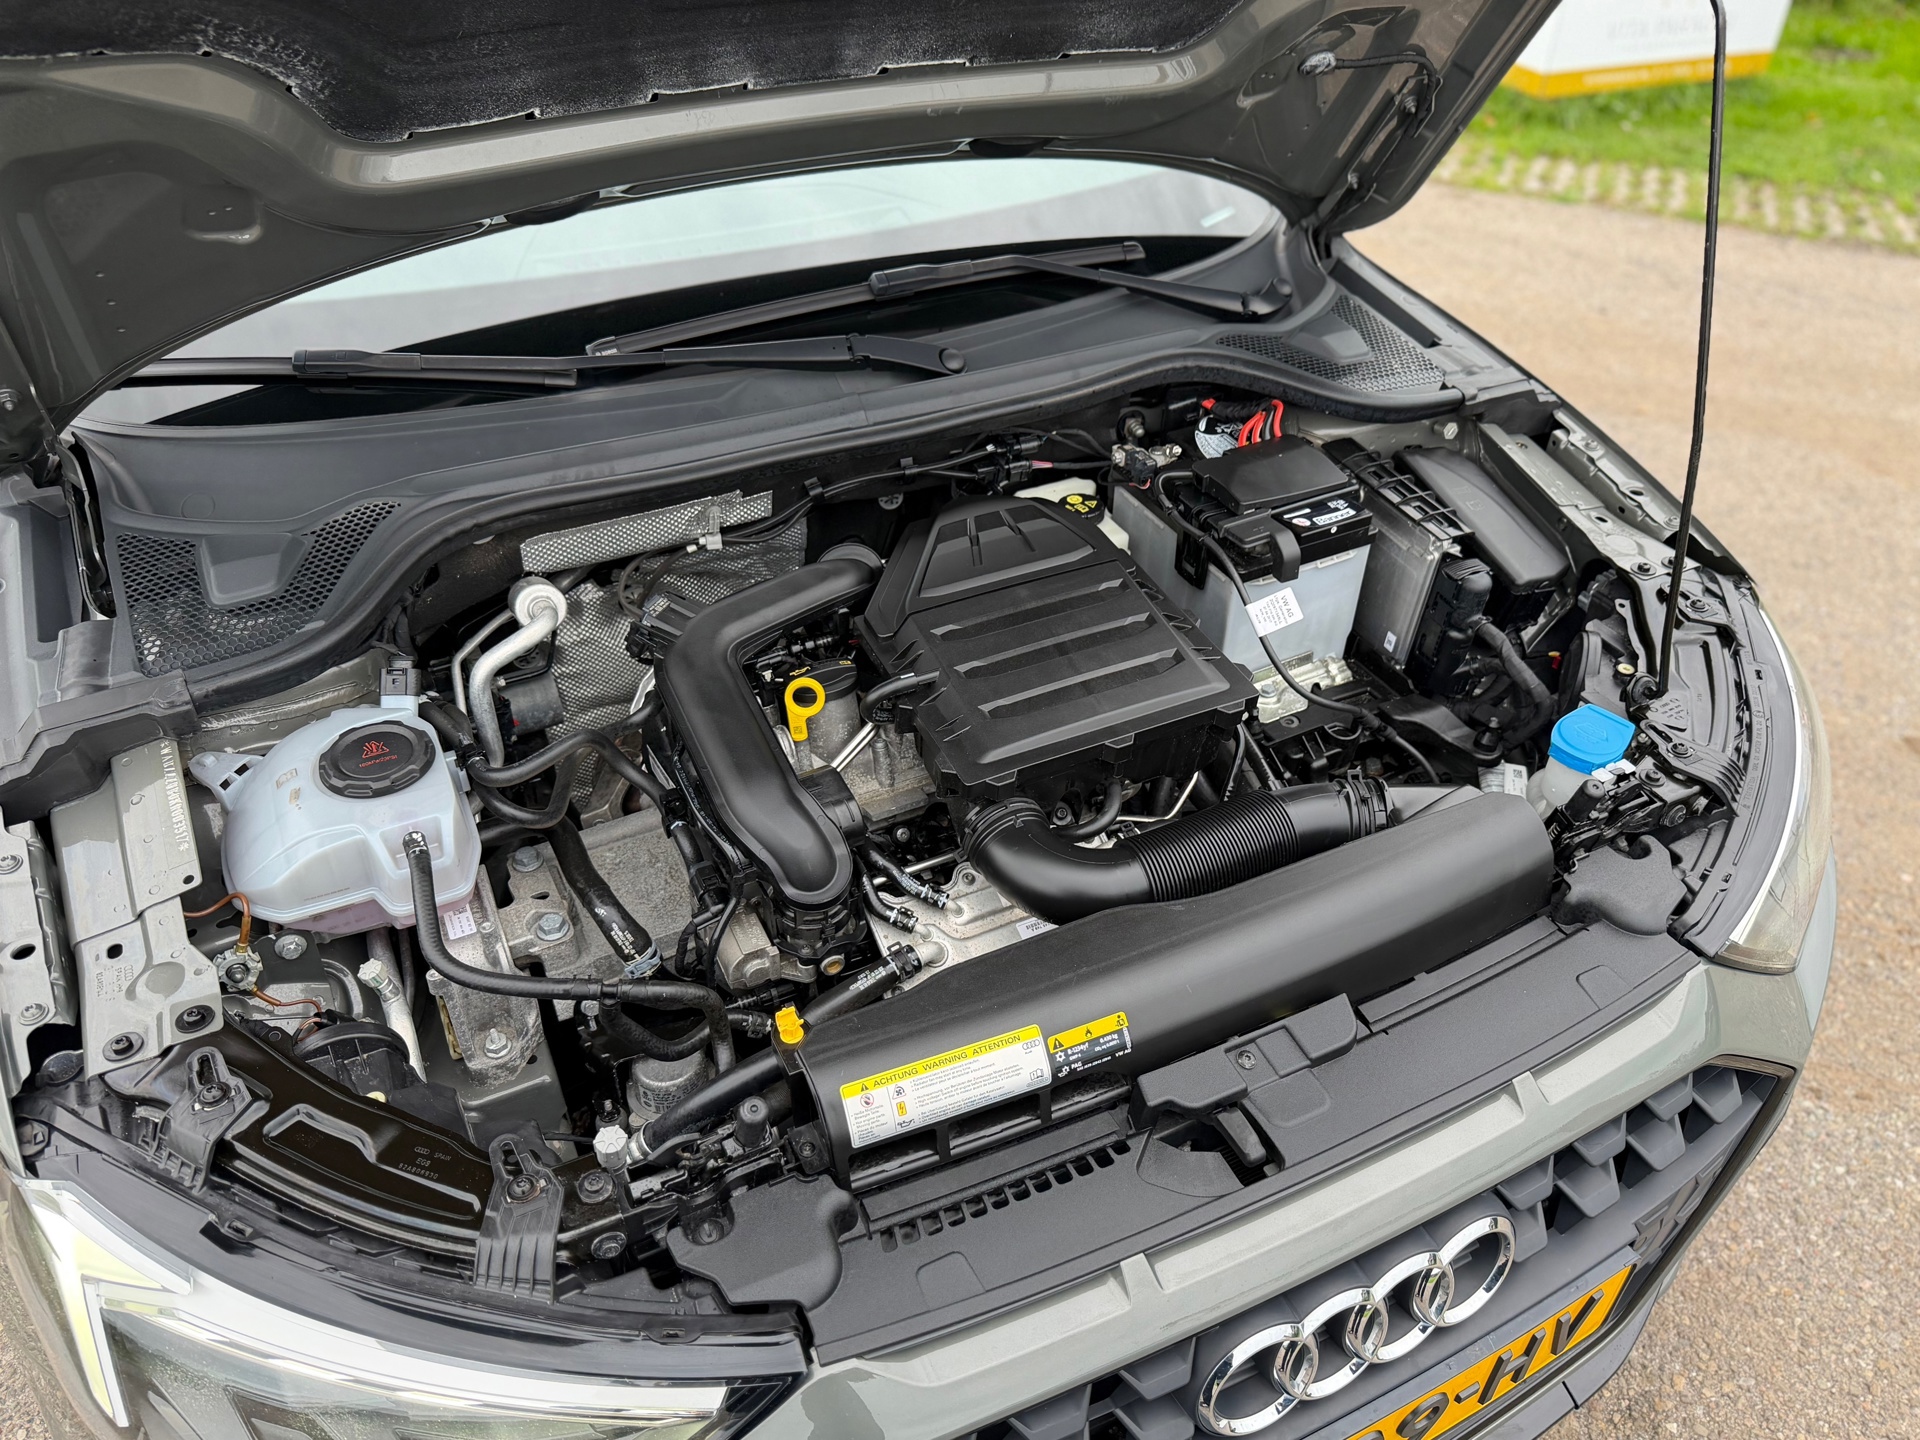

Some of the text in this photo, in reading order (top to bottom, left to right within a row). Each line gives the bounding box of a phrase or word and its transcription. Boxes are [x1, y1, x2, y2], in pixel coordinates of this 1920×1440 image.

[1315, 509, 1351, 524] Banner
[1279, 594, 1294, 618] VW AG
[873, 1035, 1021, 1087] ACHTUNG WARNING ATTENTION
[1070, 1060, 1082, 1069] PAG
[1357, 1287, 1604, 1440] 9-HV
